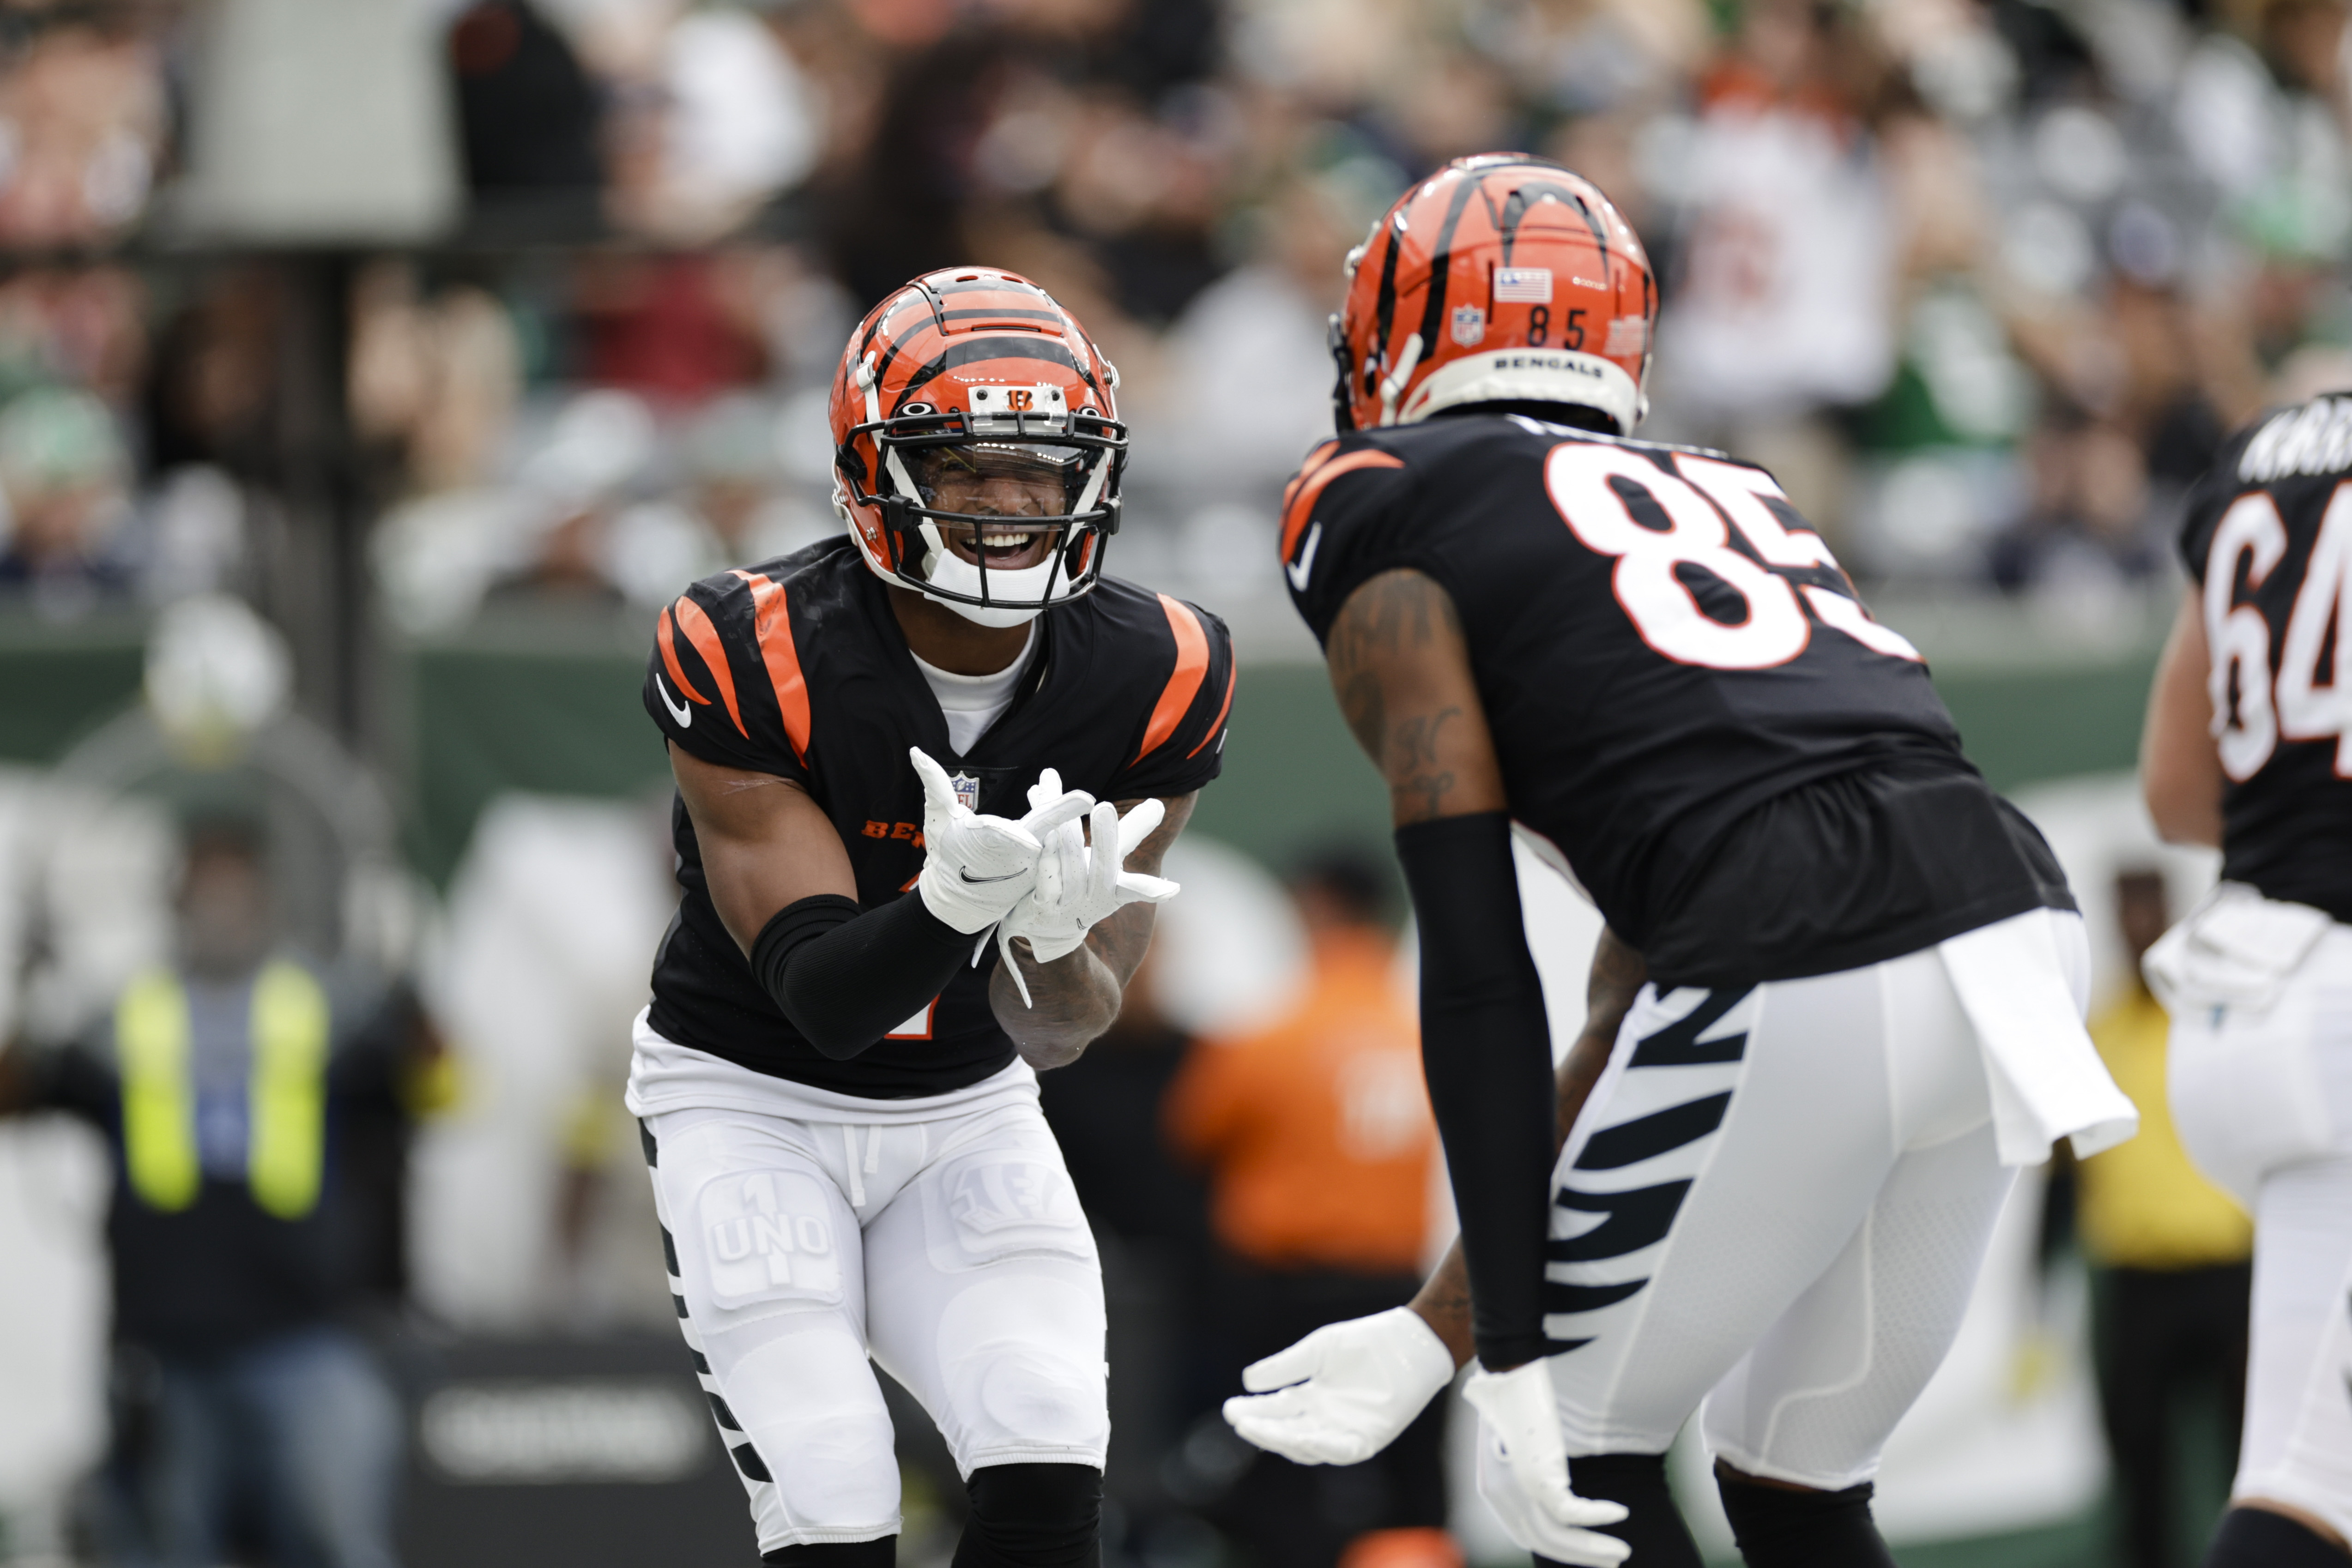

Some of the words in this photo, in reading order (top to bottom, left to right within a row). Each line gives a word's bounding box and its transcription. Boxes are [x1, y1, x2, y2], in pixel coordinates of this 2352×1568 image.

[1528, 306, 1587, 350] 85
[1495, 357, 1603, 378] BENGALS
[1544, 442, 1926, 670] 85
[2203, 478, 2352, 783] 64
[958, 794, 972, 808] FL
[713, 1214, 829, 1260] UNO
